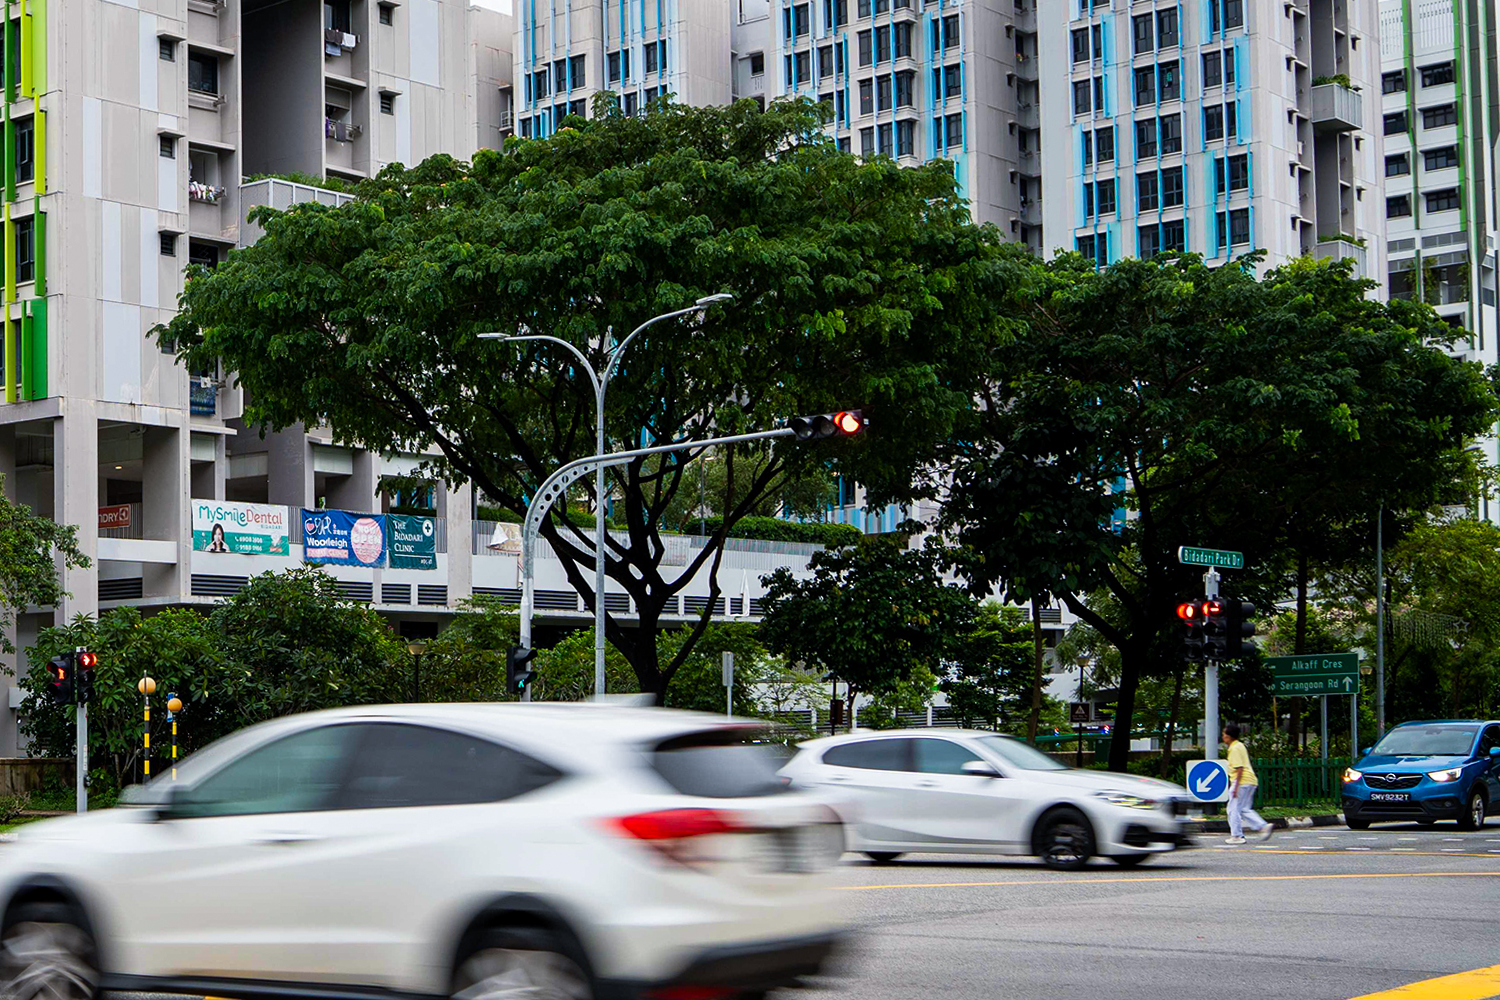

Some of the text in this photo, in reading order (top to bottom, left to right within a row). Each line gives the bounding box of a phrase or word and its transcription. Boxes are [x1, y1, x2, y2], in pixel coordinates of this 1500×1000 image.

[392, 520, 406, 530] THE
[353, 533, 381, 545] OPEN
[394, 531, 423, 542] BIDADARI
[394, 543, 414, 552] CLINIC
[1184, 549, 1240, 566] Bidadari Park Dr
[1292, 659, 1343, 670] Alkaff Cres
[1280, 681, 1324, 692] Serangoon
[1328, 678, 1339, 688] Rd
